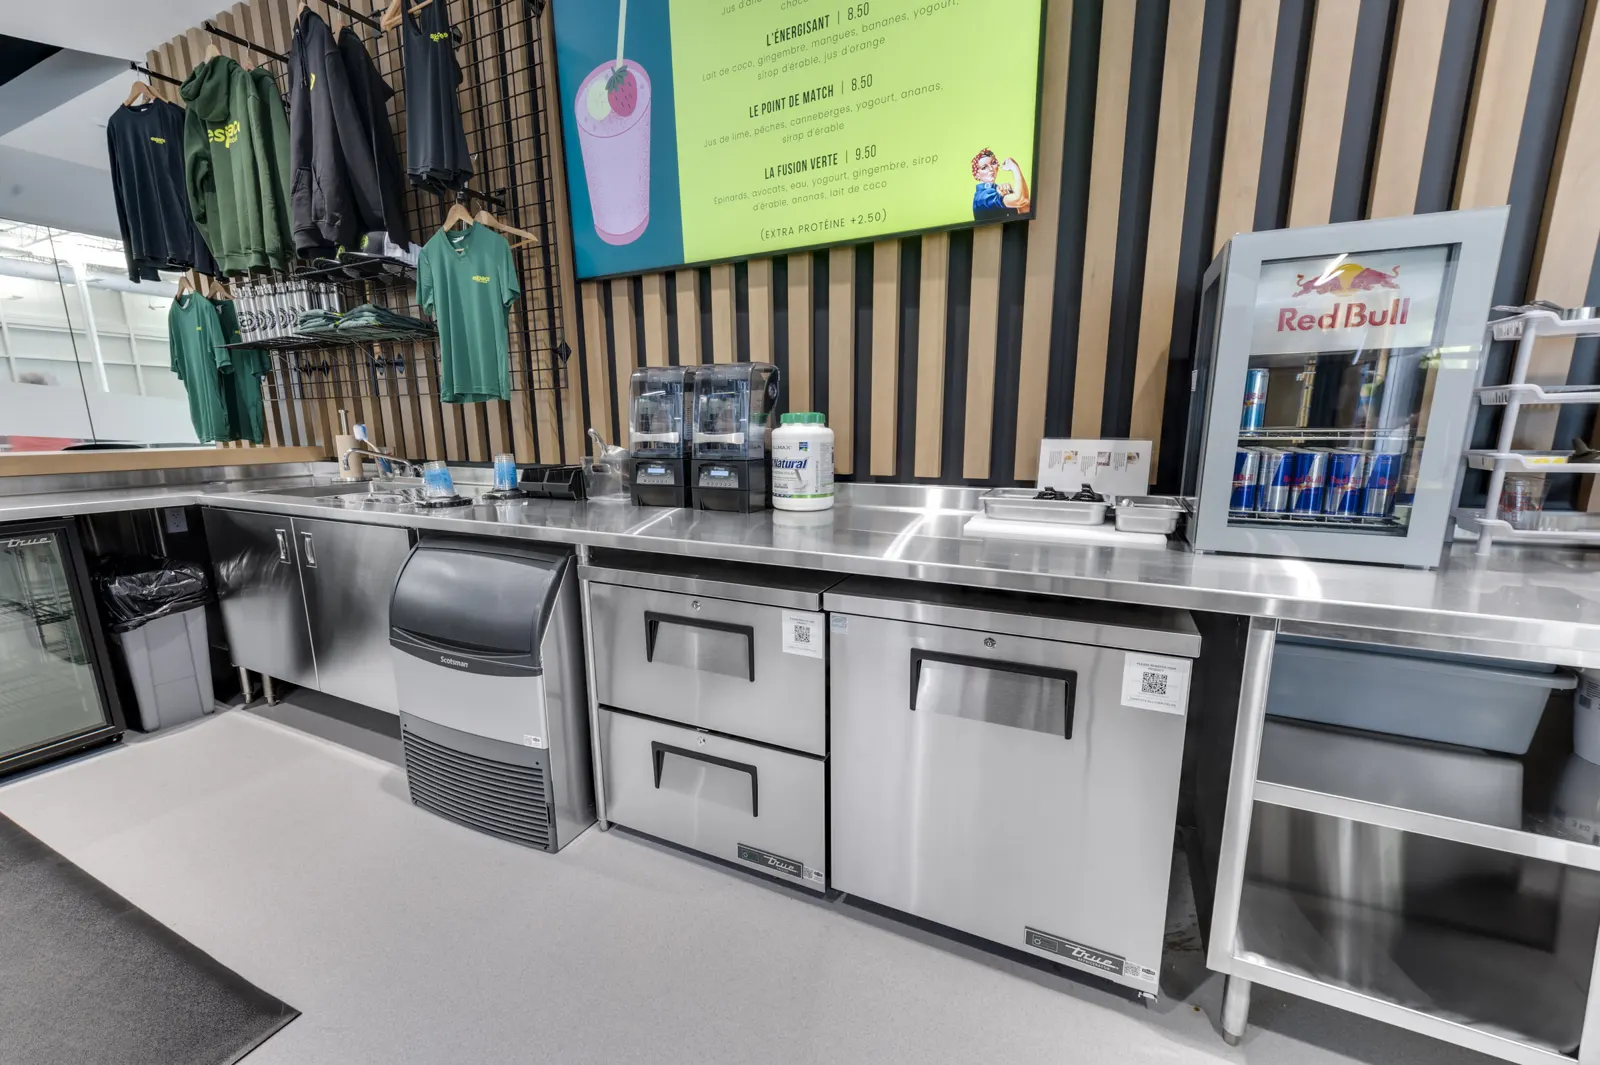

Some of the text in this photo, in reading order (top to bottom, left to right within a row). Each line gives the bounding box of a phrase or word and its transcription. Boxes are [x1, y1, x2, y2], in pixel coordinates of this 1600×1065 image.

[766, 1, 870, 47] L'ÉNERGISANT 8.50
[702, 70, 717, 82] Lait
[719, 66, 730, 77] de
[757, 43, 809, 67] gingembre,
[811, 28, 859, 49] mangues,
[861, 12, 910, 33] bananes,
[757, 36, 886, 81] sirop d'érable, jus d'orange
[703, 82, 944, 148] Jus de lime, pêches, canneberges, yogourt, ananas,
[749, 73, 873, 119] LE POINT DE MATCH 8.50
[782, 121, 845, 144] sirop d'érable
[713, 154, 939, 205] Épinards, avocats, eau, yogourt, gingembre, sirop
[764, 144, 877, 180] LA FUSION VERTE 9.50
[752, 198, 789, 212] d'érable,
[791, 190, 827, 205] ananas,
[829, 187, 845, 197] lait
[847, 184, 860, 194] de
[760, 207, 887, 241] (EXTRA PROTÉINE +2.50)
[1277, 297, 1411, 333] Red Bull
[440, 655, 469, 668] Scotsman
